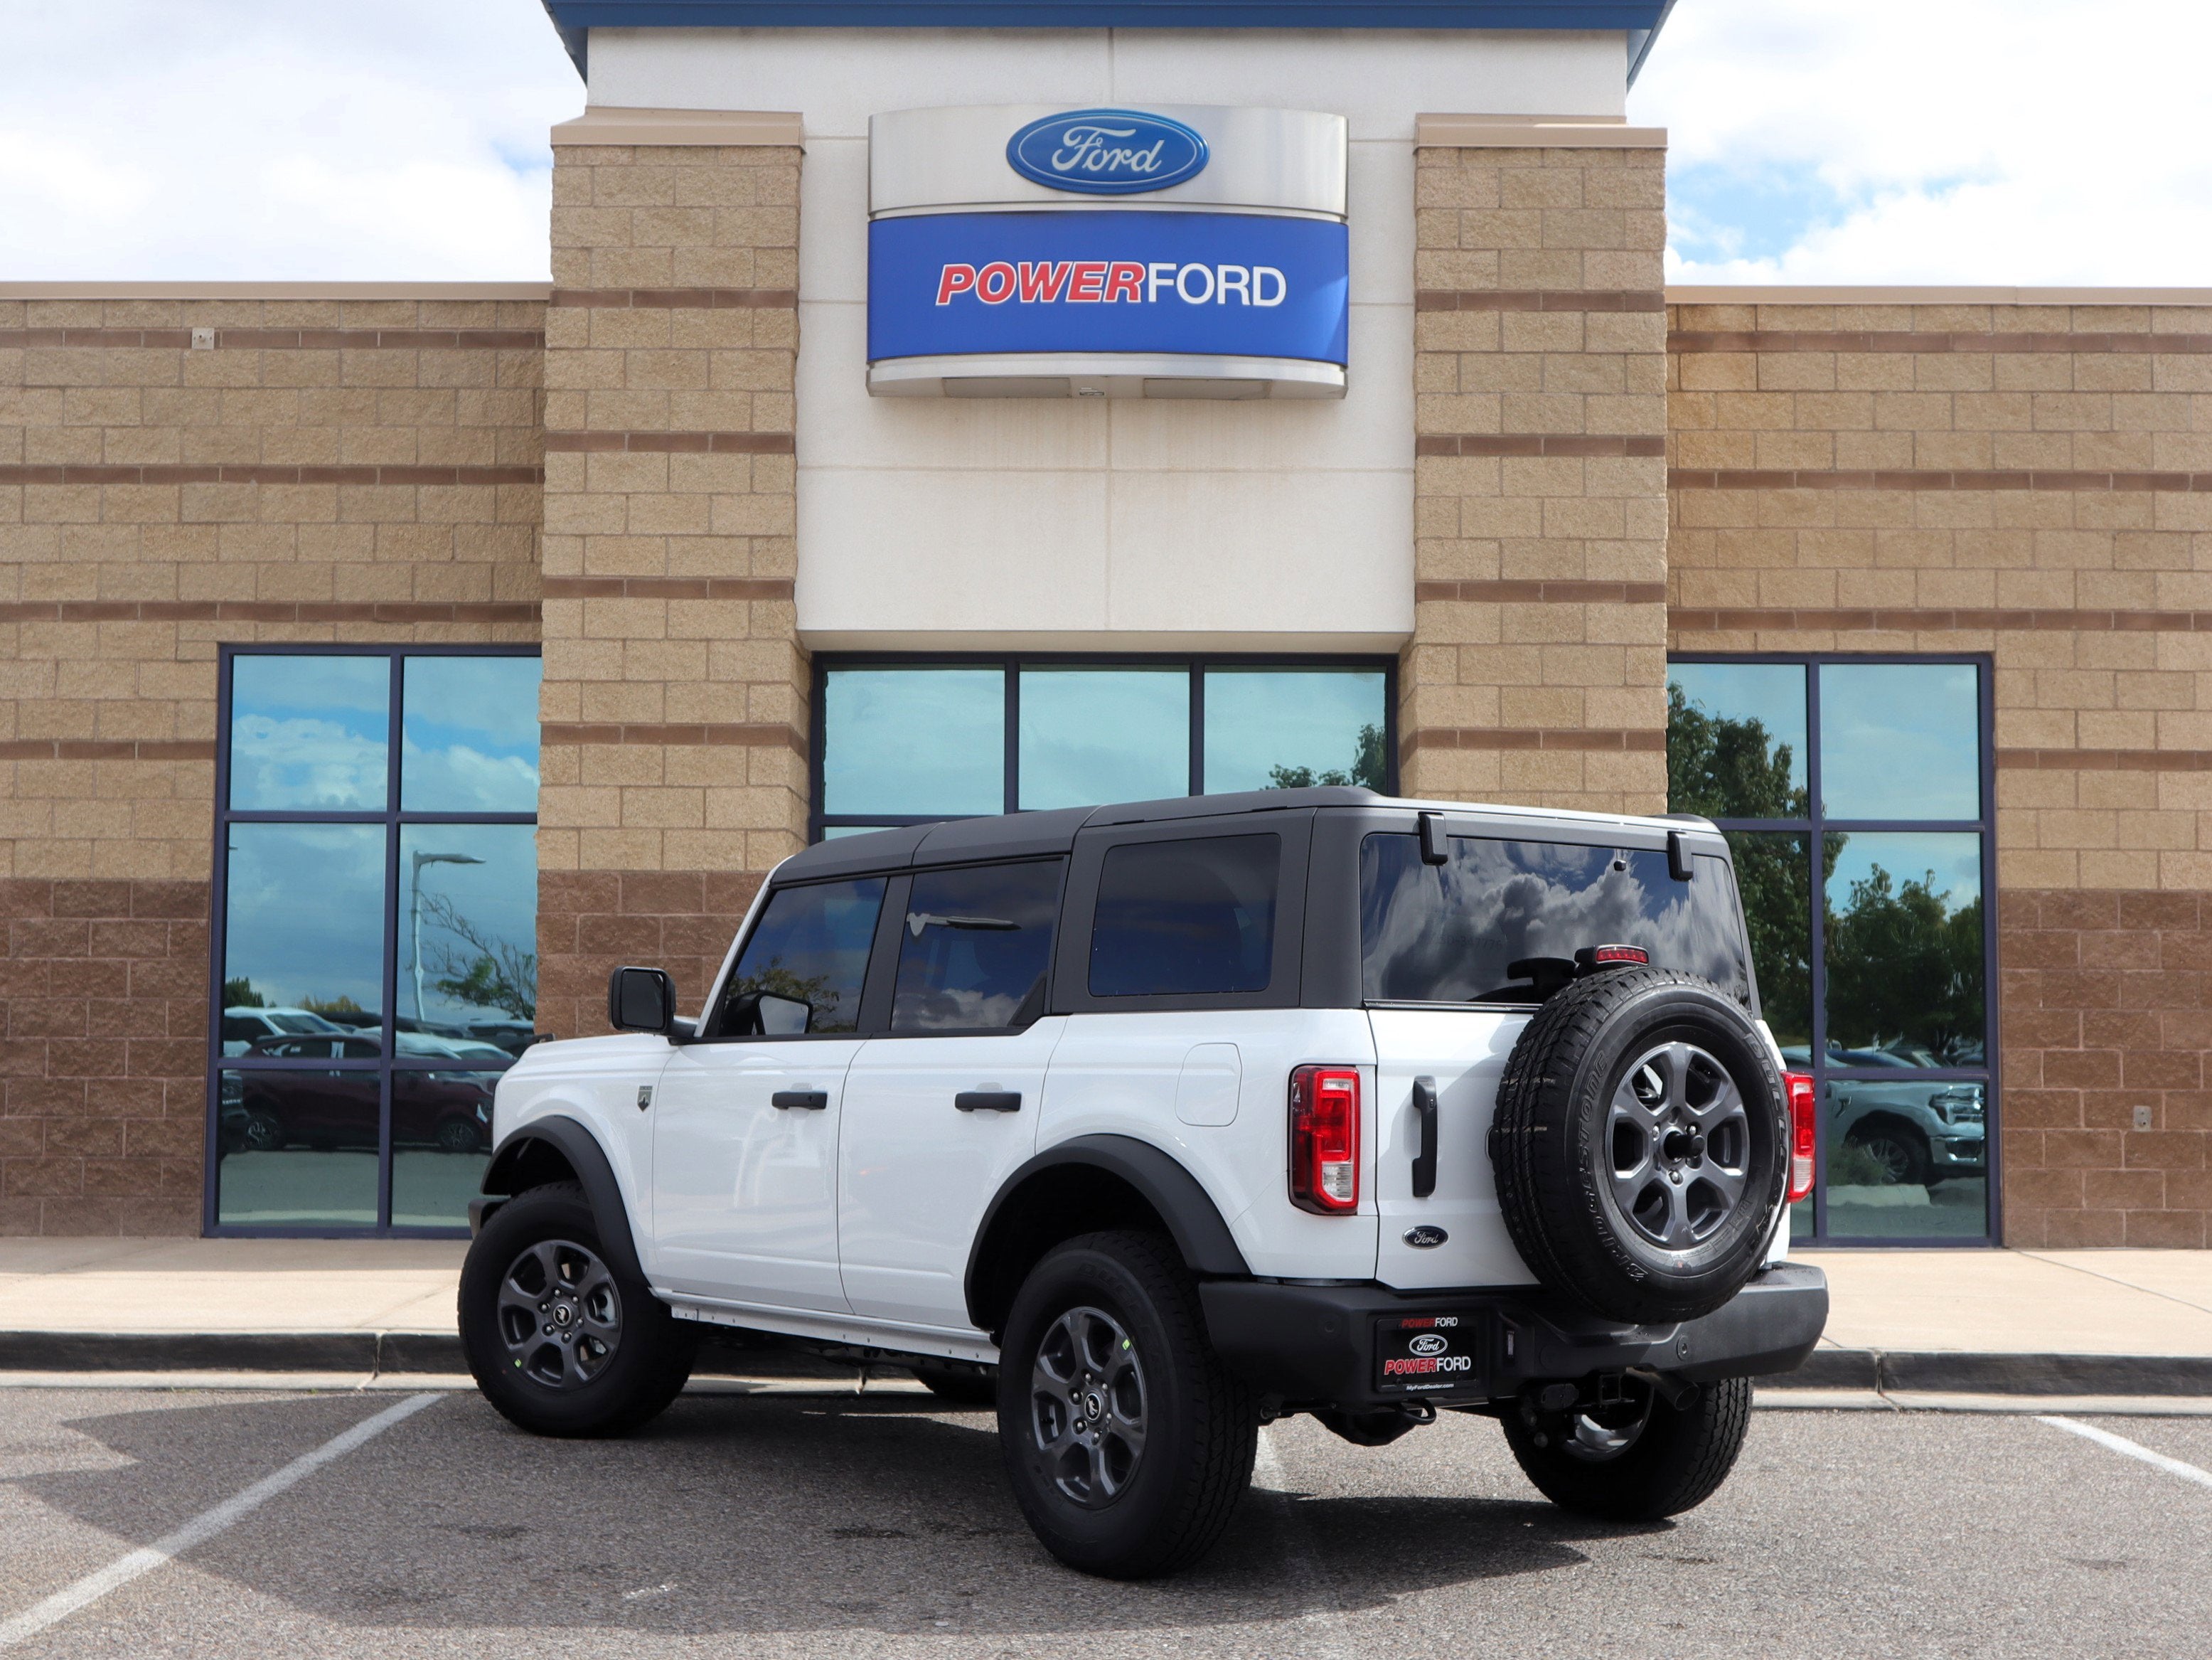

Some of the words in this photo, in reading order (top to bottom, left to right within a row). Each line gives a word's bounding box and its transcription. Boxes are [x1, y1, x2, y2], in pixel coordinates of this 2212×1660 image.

[1051, 125, 1165, 173] Ford
[1414, 1231, 1439, 1245] Ford
[1416, 1338, 1441, 1352] Ford
[1406, 1383, 1455, 1392] MyFordDealer.com
